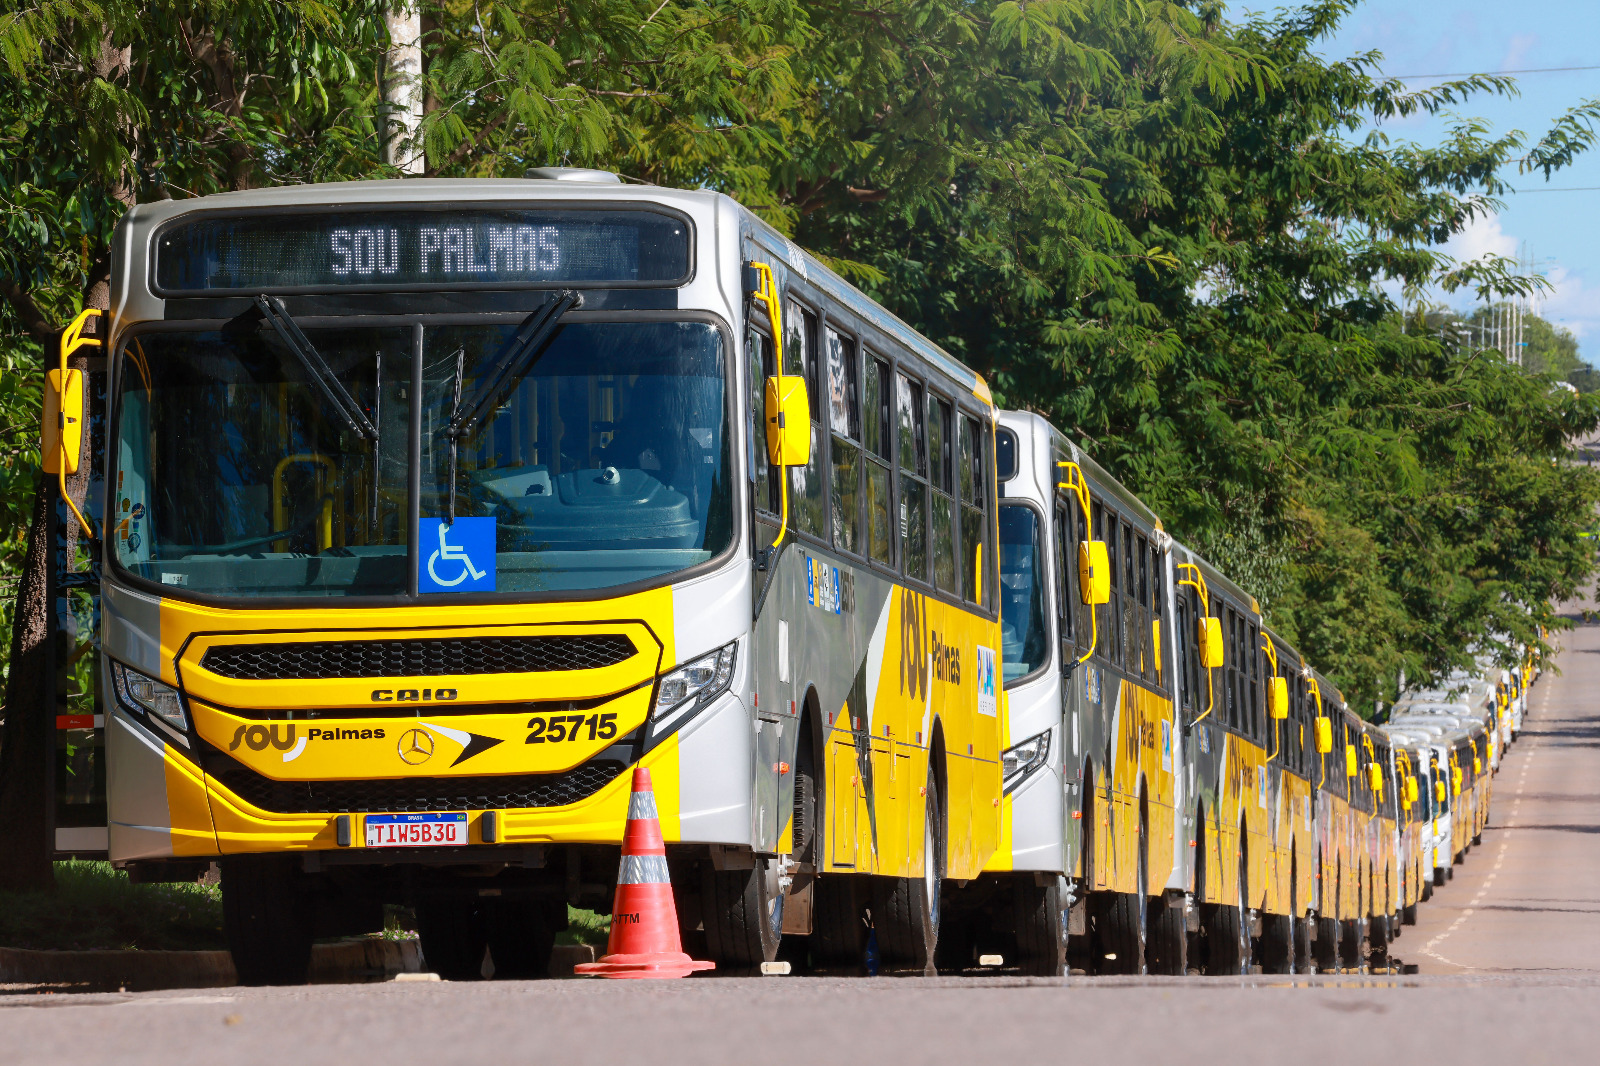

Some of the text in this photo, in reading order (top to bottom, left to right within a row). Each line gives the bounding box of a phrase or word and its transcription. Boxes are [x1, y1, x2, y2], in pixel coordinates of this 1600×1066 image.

[331, 226, 559, 274] SOU PALMAS
[931, 629, 961, 686] Palmas
[370, 688, 458, 702] CAIO
[308, 727, 386, 741] Palmas
[524, 712, 618, 745] 25715
[374, 823, 457, 844] TIW5B30
[612, 912, 640, 925] ATTM
